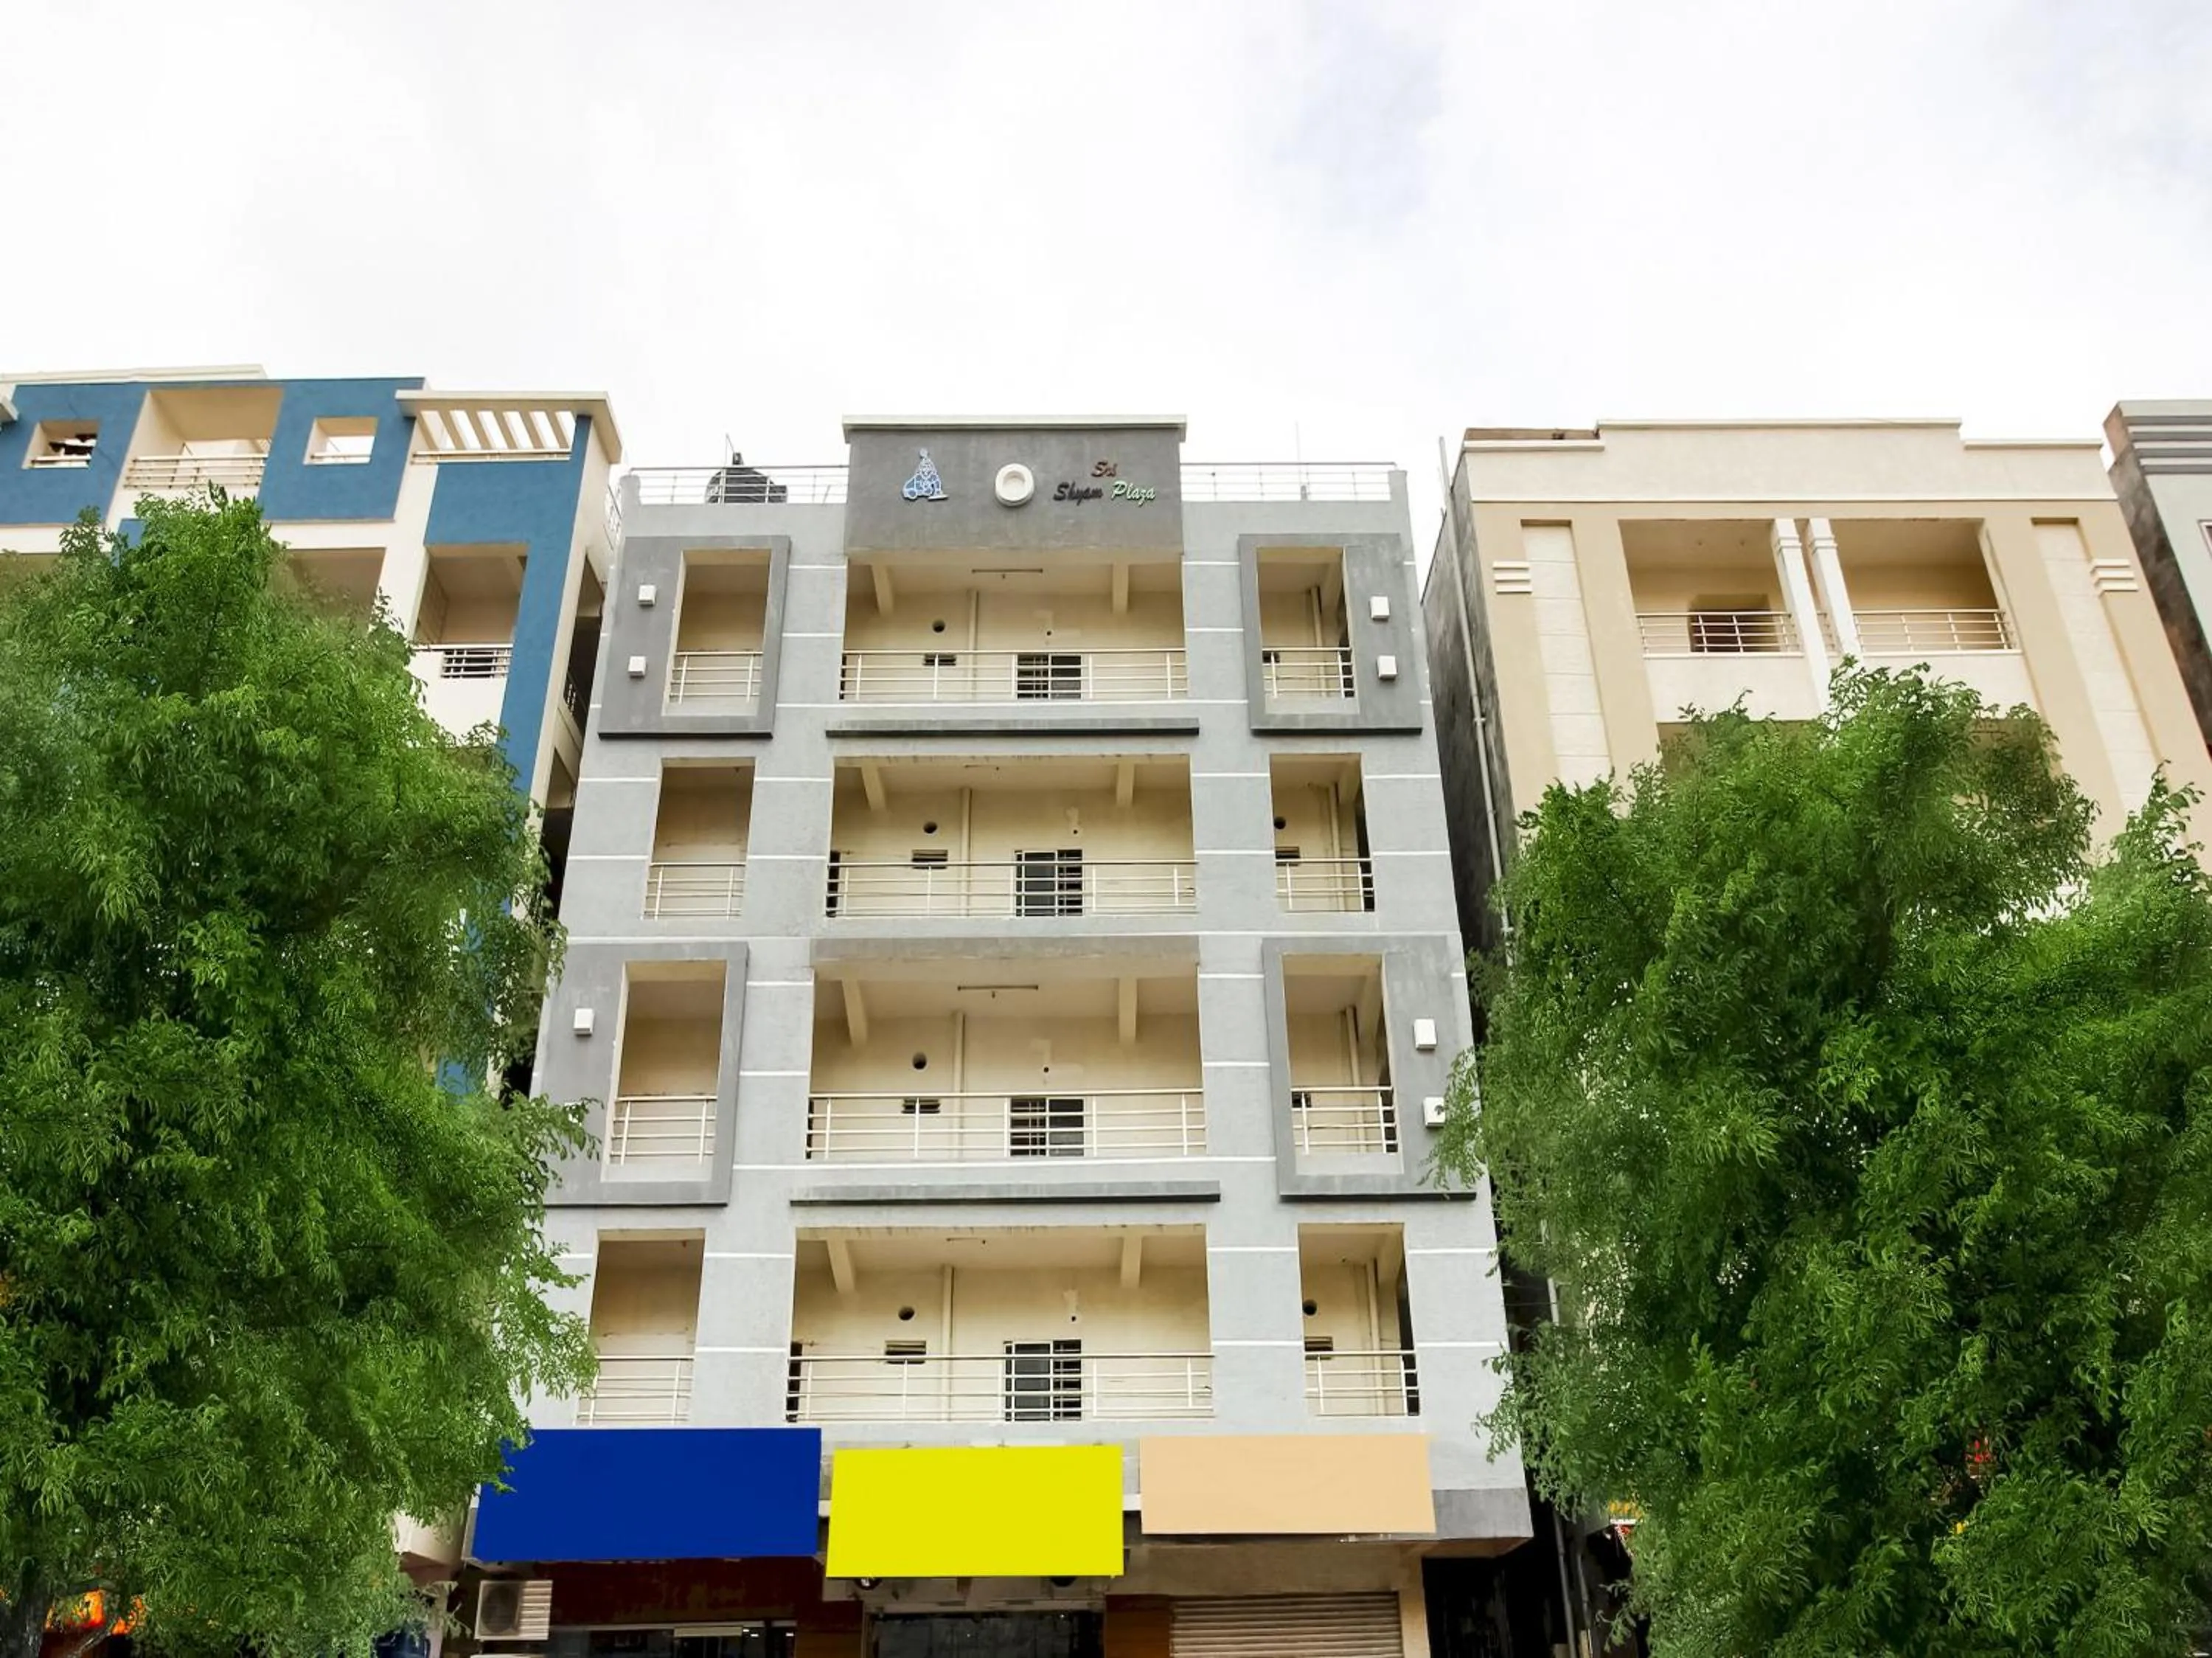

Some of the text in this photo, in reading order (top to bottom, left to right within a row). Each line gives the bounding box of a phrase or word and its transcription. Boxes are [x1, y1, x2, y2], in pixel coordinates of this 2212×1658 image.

[1091, 460, 1118, 478] Sri
[1053, 480, 1156, 507] Shyam Plaza
